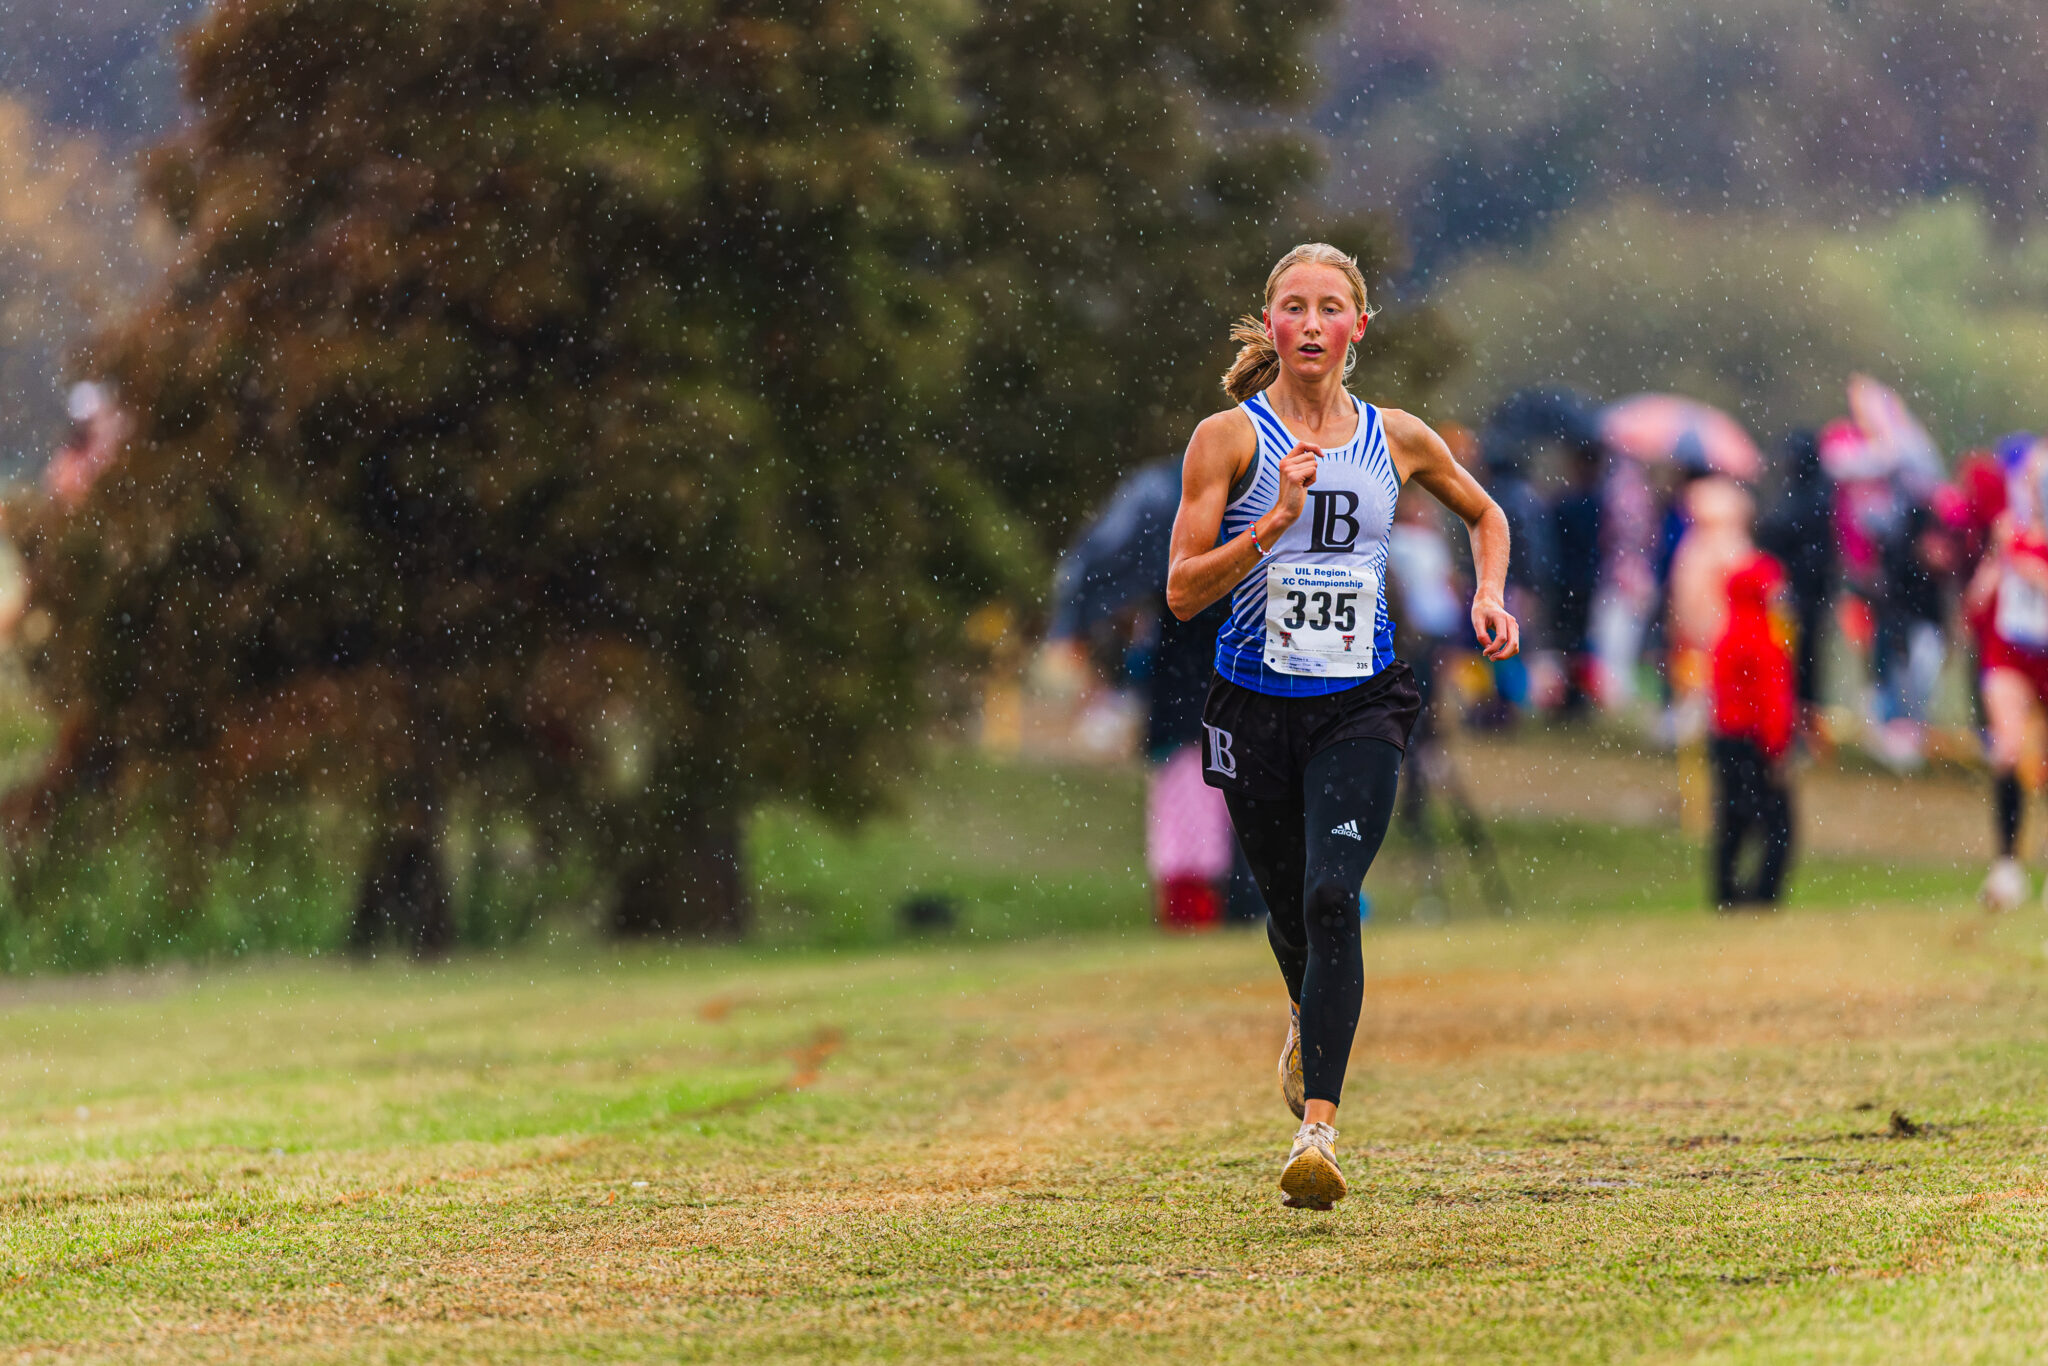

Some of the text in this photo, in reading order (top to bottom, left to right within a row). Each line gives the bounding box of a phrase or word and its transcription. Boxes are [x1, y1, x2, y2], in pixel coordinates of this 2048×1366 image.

[1314, 568, 1346, 578] Region
[1282, 577, 1363, 589] XC Championship
[1283, 590, 1358, 632] 335
[1356, 662, 1368, 670] 335
[1331, 828, 1362, 841] adidas
